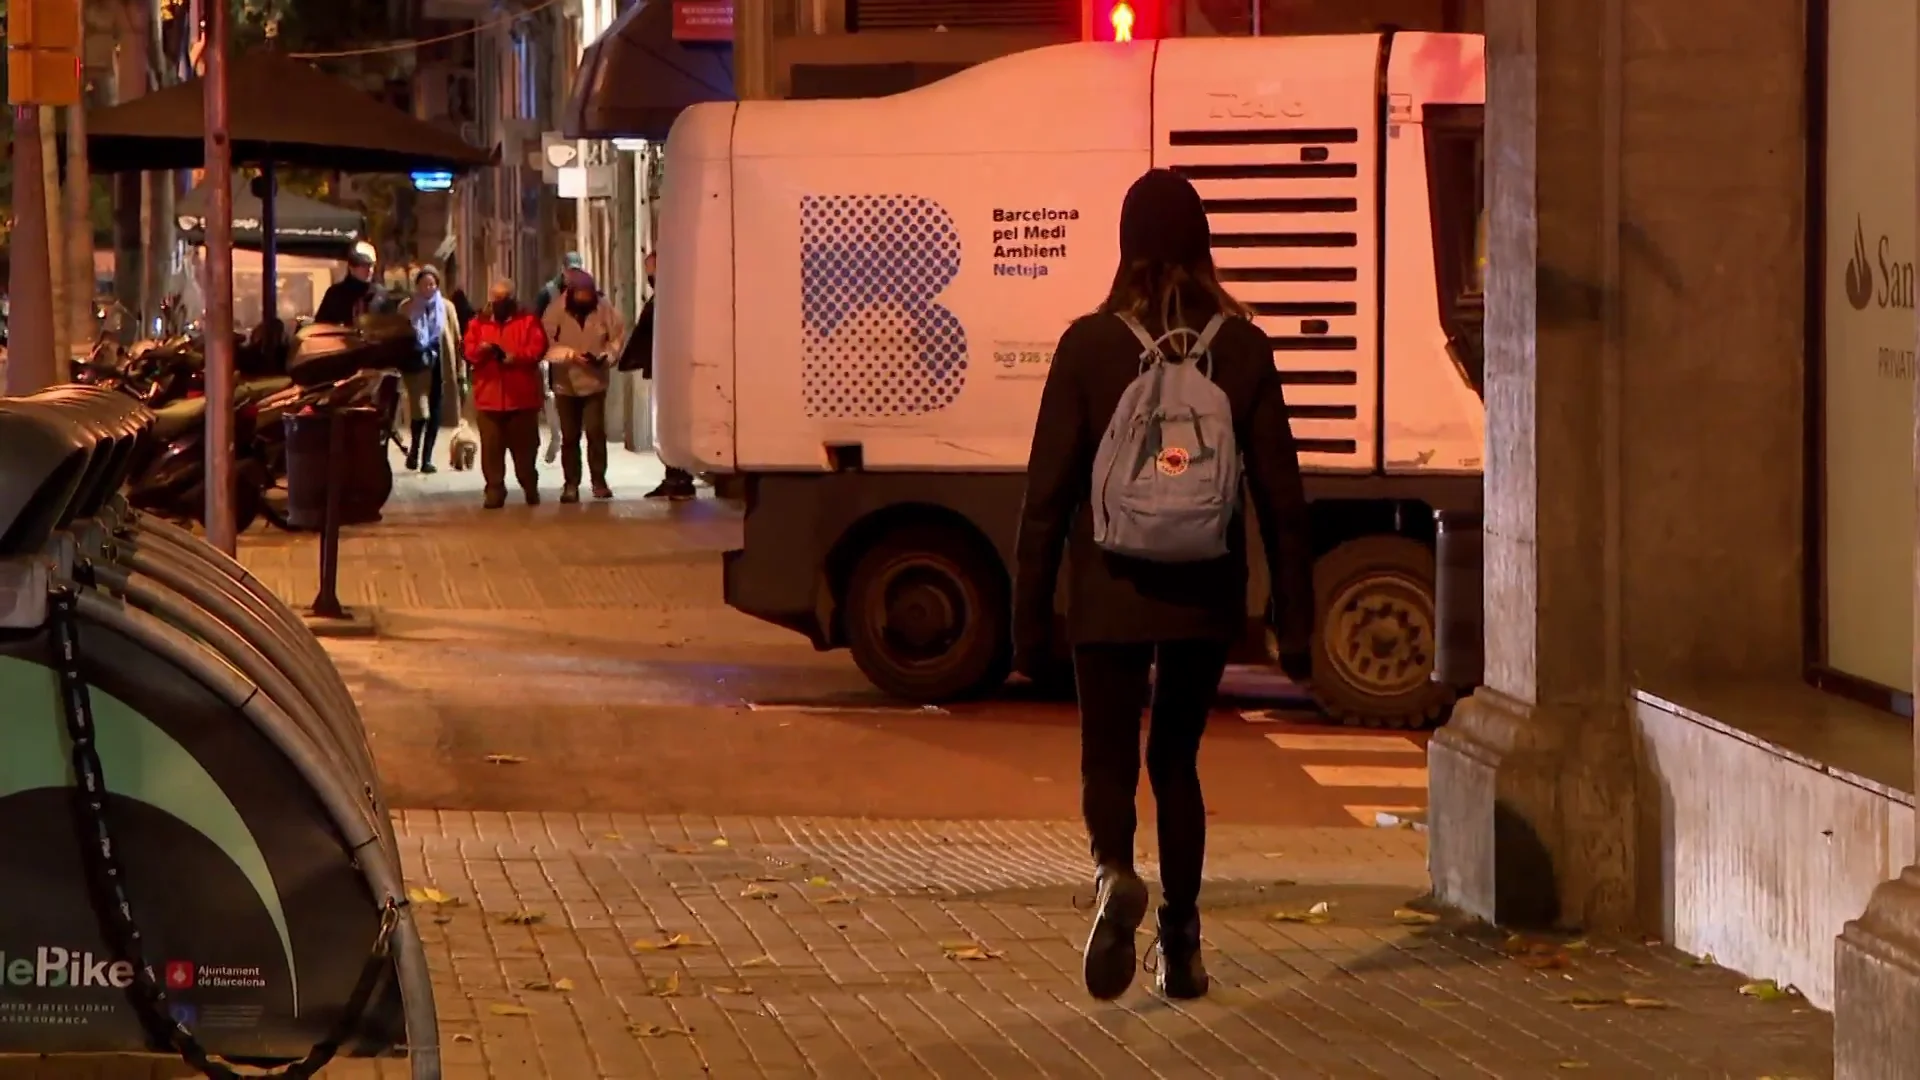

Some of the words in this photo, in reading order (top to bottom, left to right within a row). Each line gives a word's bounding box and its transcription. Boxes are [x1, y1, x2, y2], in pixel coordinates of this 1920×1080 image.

[993, 208, 1080, 223] Barcelona
[993, 226, 1018, 243] pel
[1024, 225, 1066, 239] Medi
[993, 243, 1067, 258] Ambient
[1877, 233, 1915, 310] San
[198, 964, 260, 977] Ajuntament
[198, 977, 211, 987] de
[213, 977, 266, 987] Barcelona
